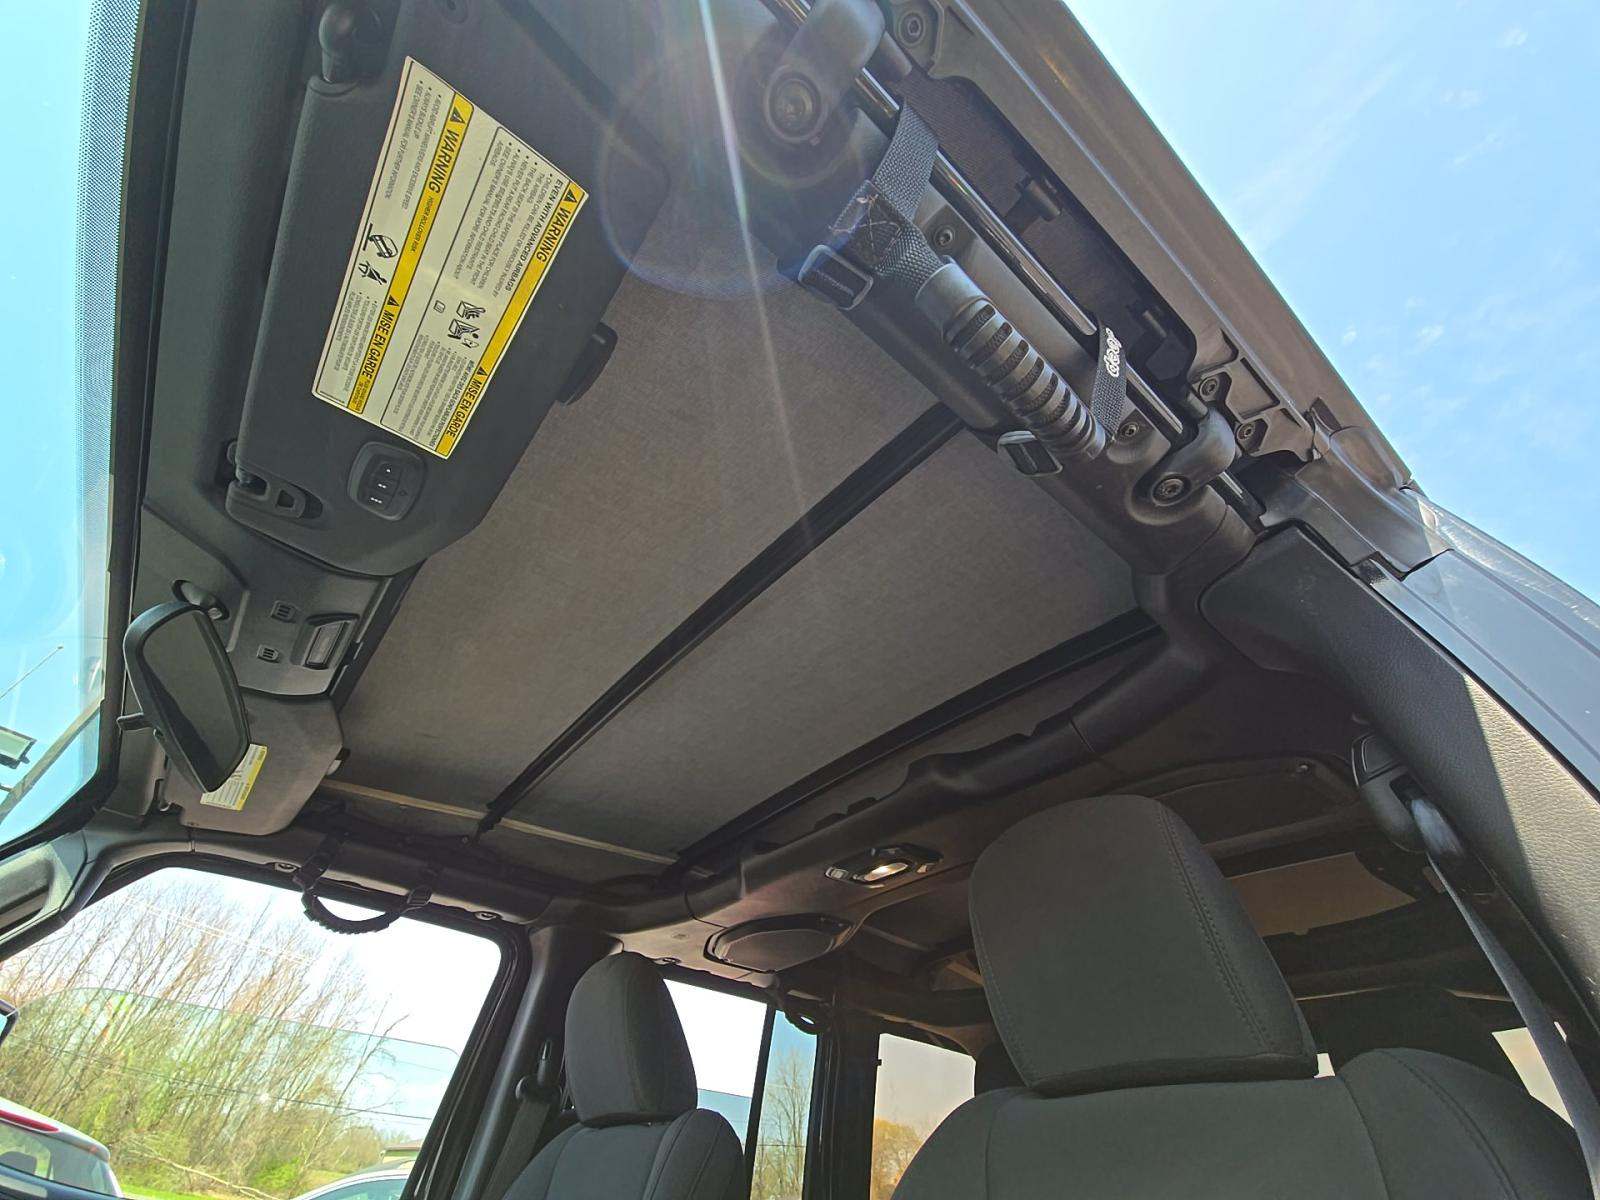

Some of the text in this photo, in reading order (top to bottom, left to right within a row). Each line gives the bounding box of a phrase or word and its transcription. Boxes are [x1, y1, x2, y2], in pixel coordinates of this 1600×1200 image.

[427, 127, 460, 194] WARNING
[504, 178, 564, 291] EVEN WITH ADVANCED AIRBAGS
[534, 205, 570, 263] WARNING
[377, 309, 394, 334] MISE
[372, 333, 385, 349] EN
[361, 346, 380, 379] GARDE
[465, 378, 482, 400] MISE
[459, 398, 472, 411] EN
[445, 410, 466, 437] GARDE
